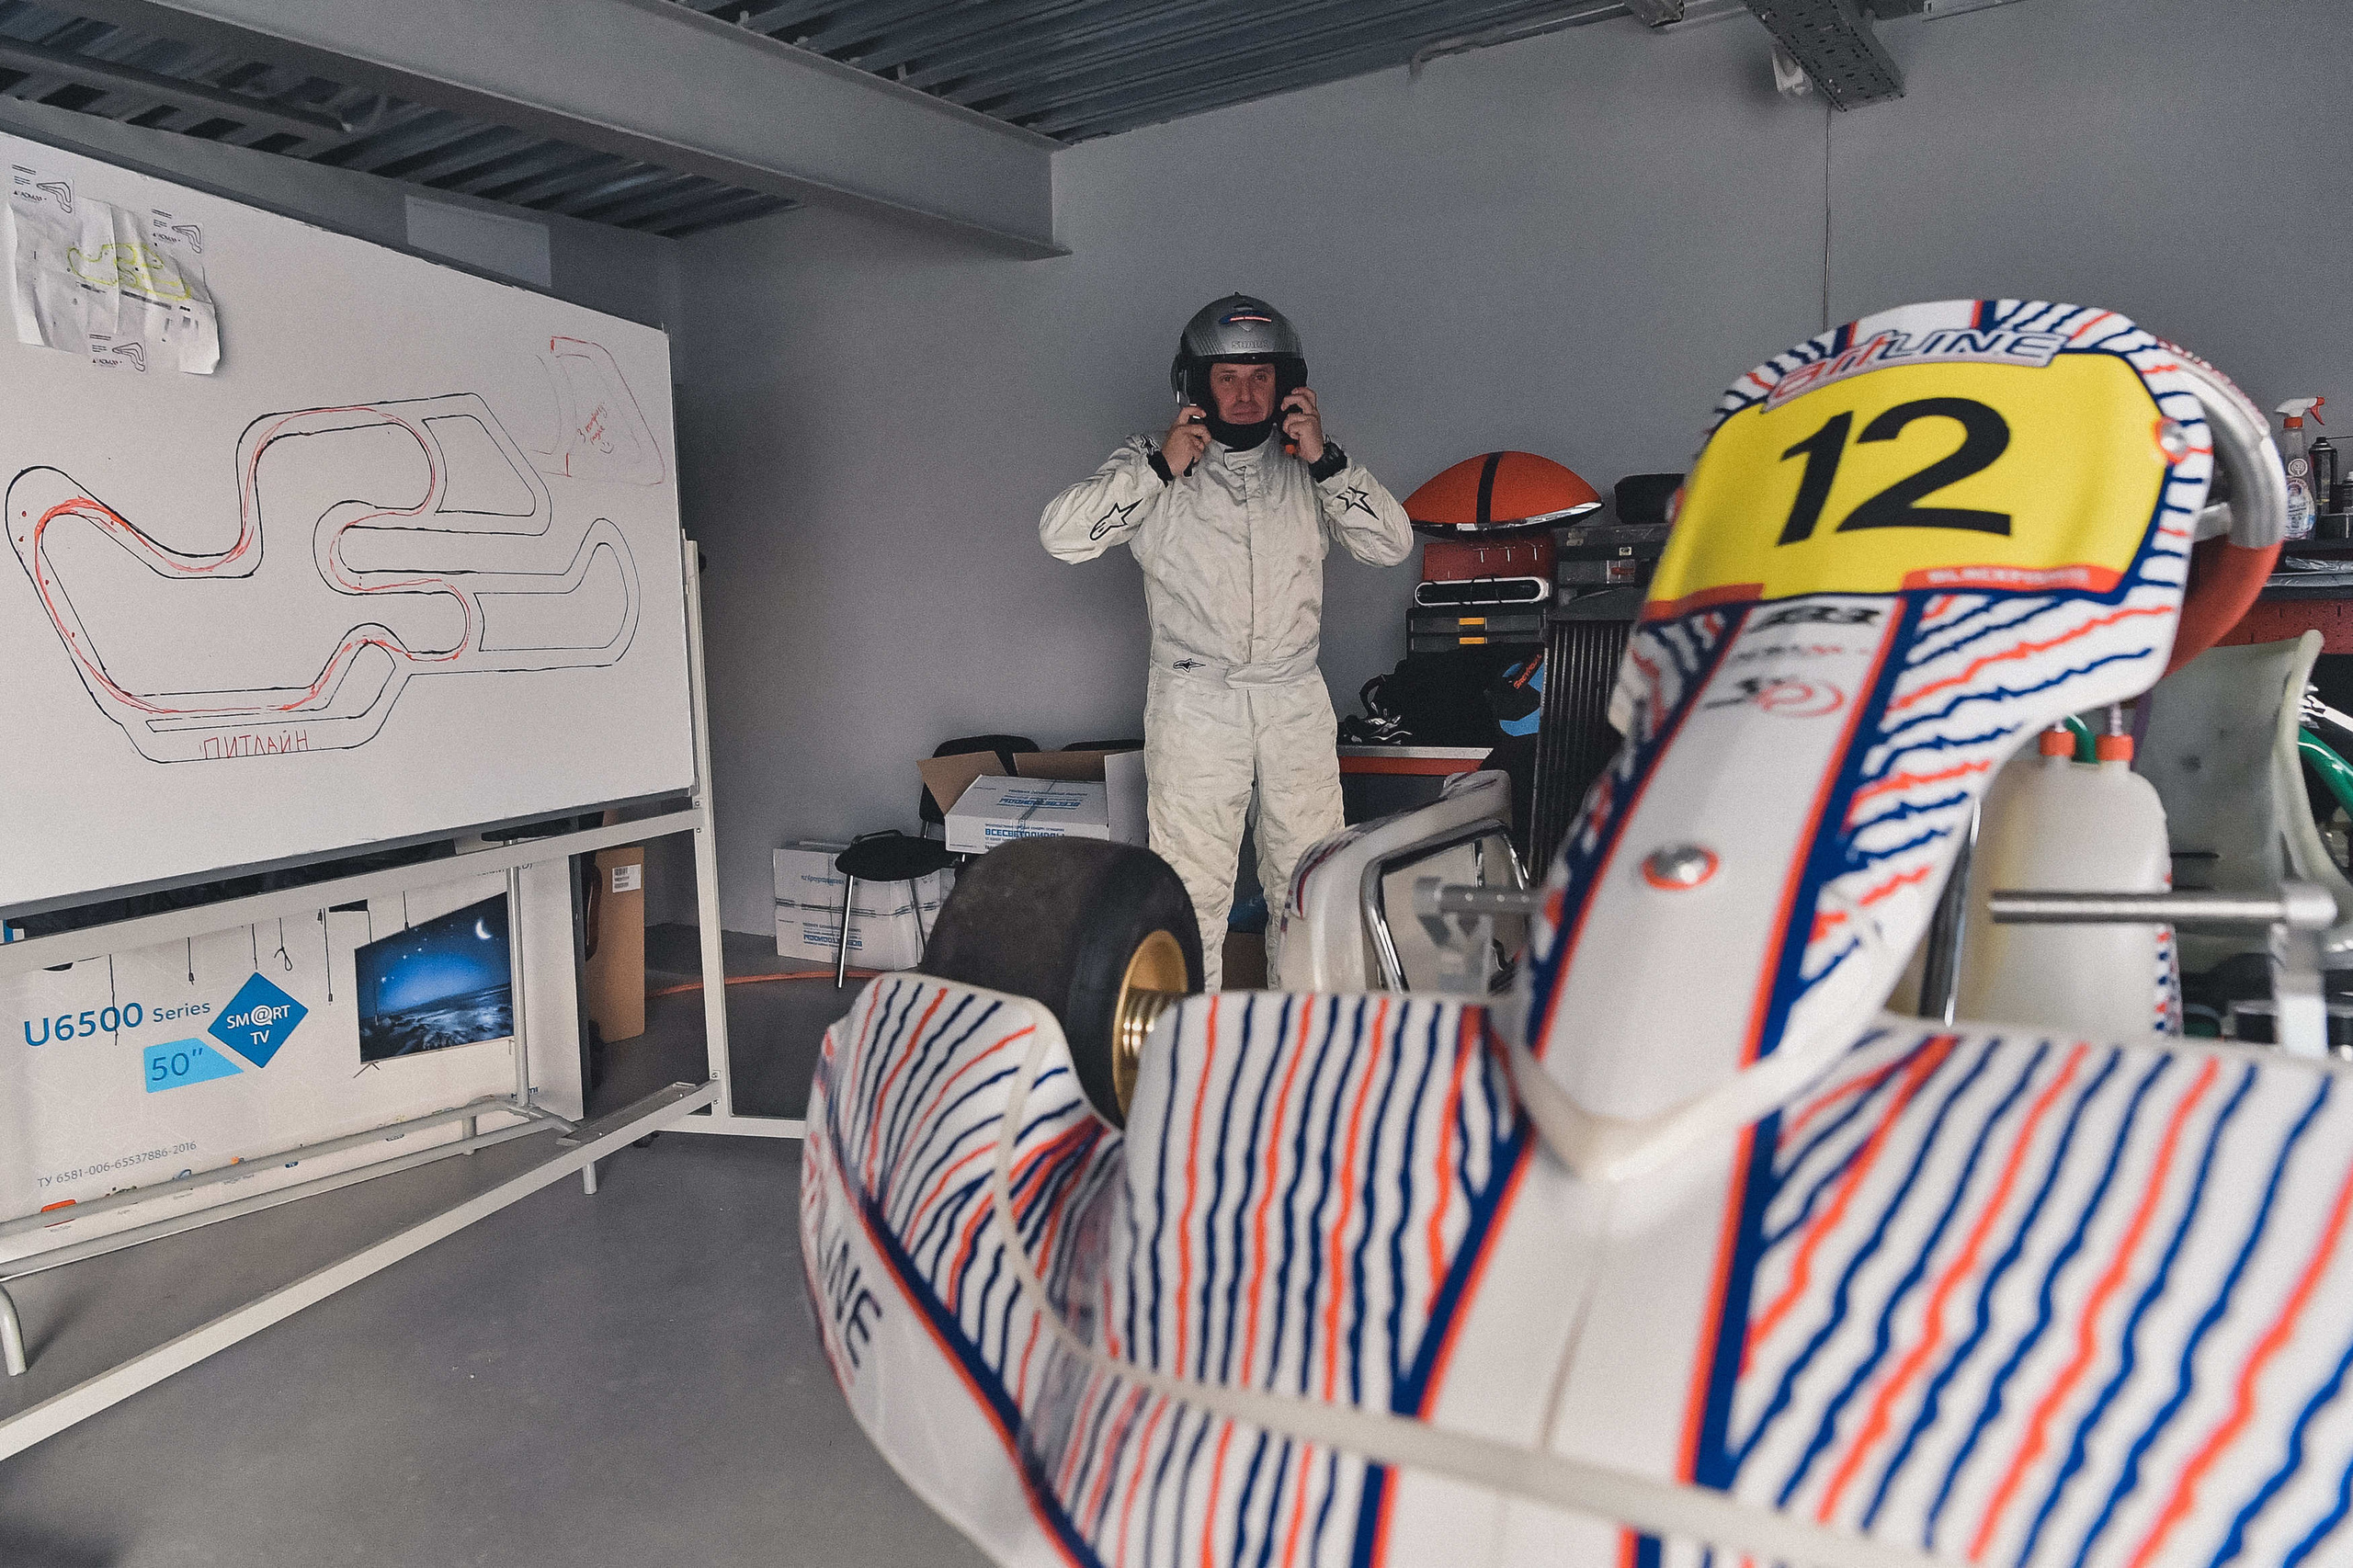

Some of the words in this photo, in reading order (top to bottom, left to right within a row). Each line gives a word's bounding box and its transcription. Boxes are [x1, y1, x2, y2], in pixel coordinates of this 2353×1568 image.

[1775, 397, 2012, 548] 12
[203, 729, 309, 760] ПИТЛАЙН
[24, 1002, 143, 1047] U6500
[153, 1002, 210, 1023] Series
[226, 1004, 291, 1029] SM@RT
[249, 1029, 270, 1045] TV
[152, 1048, 203, 1081] 50"
[56, 1141, 197, 1184] 6581-006-65537886-2016
